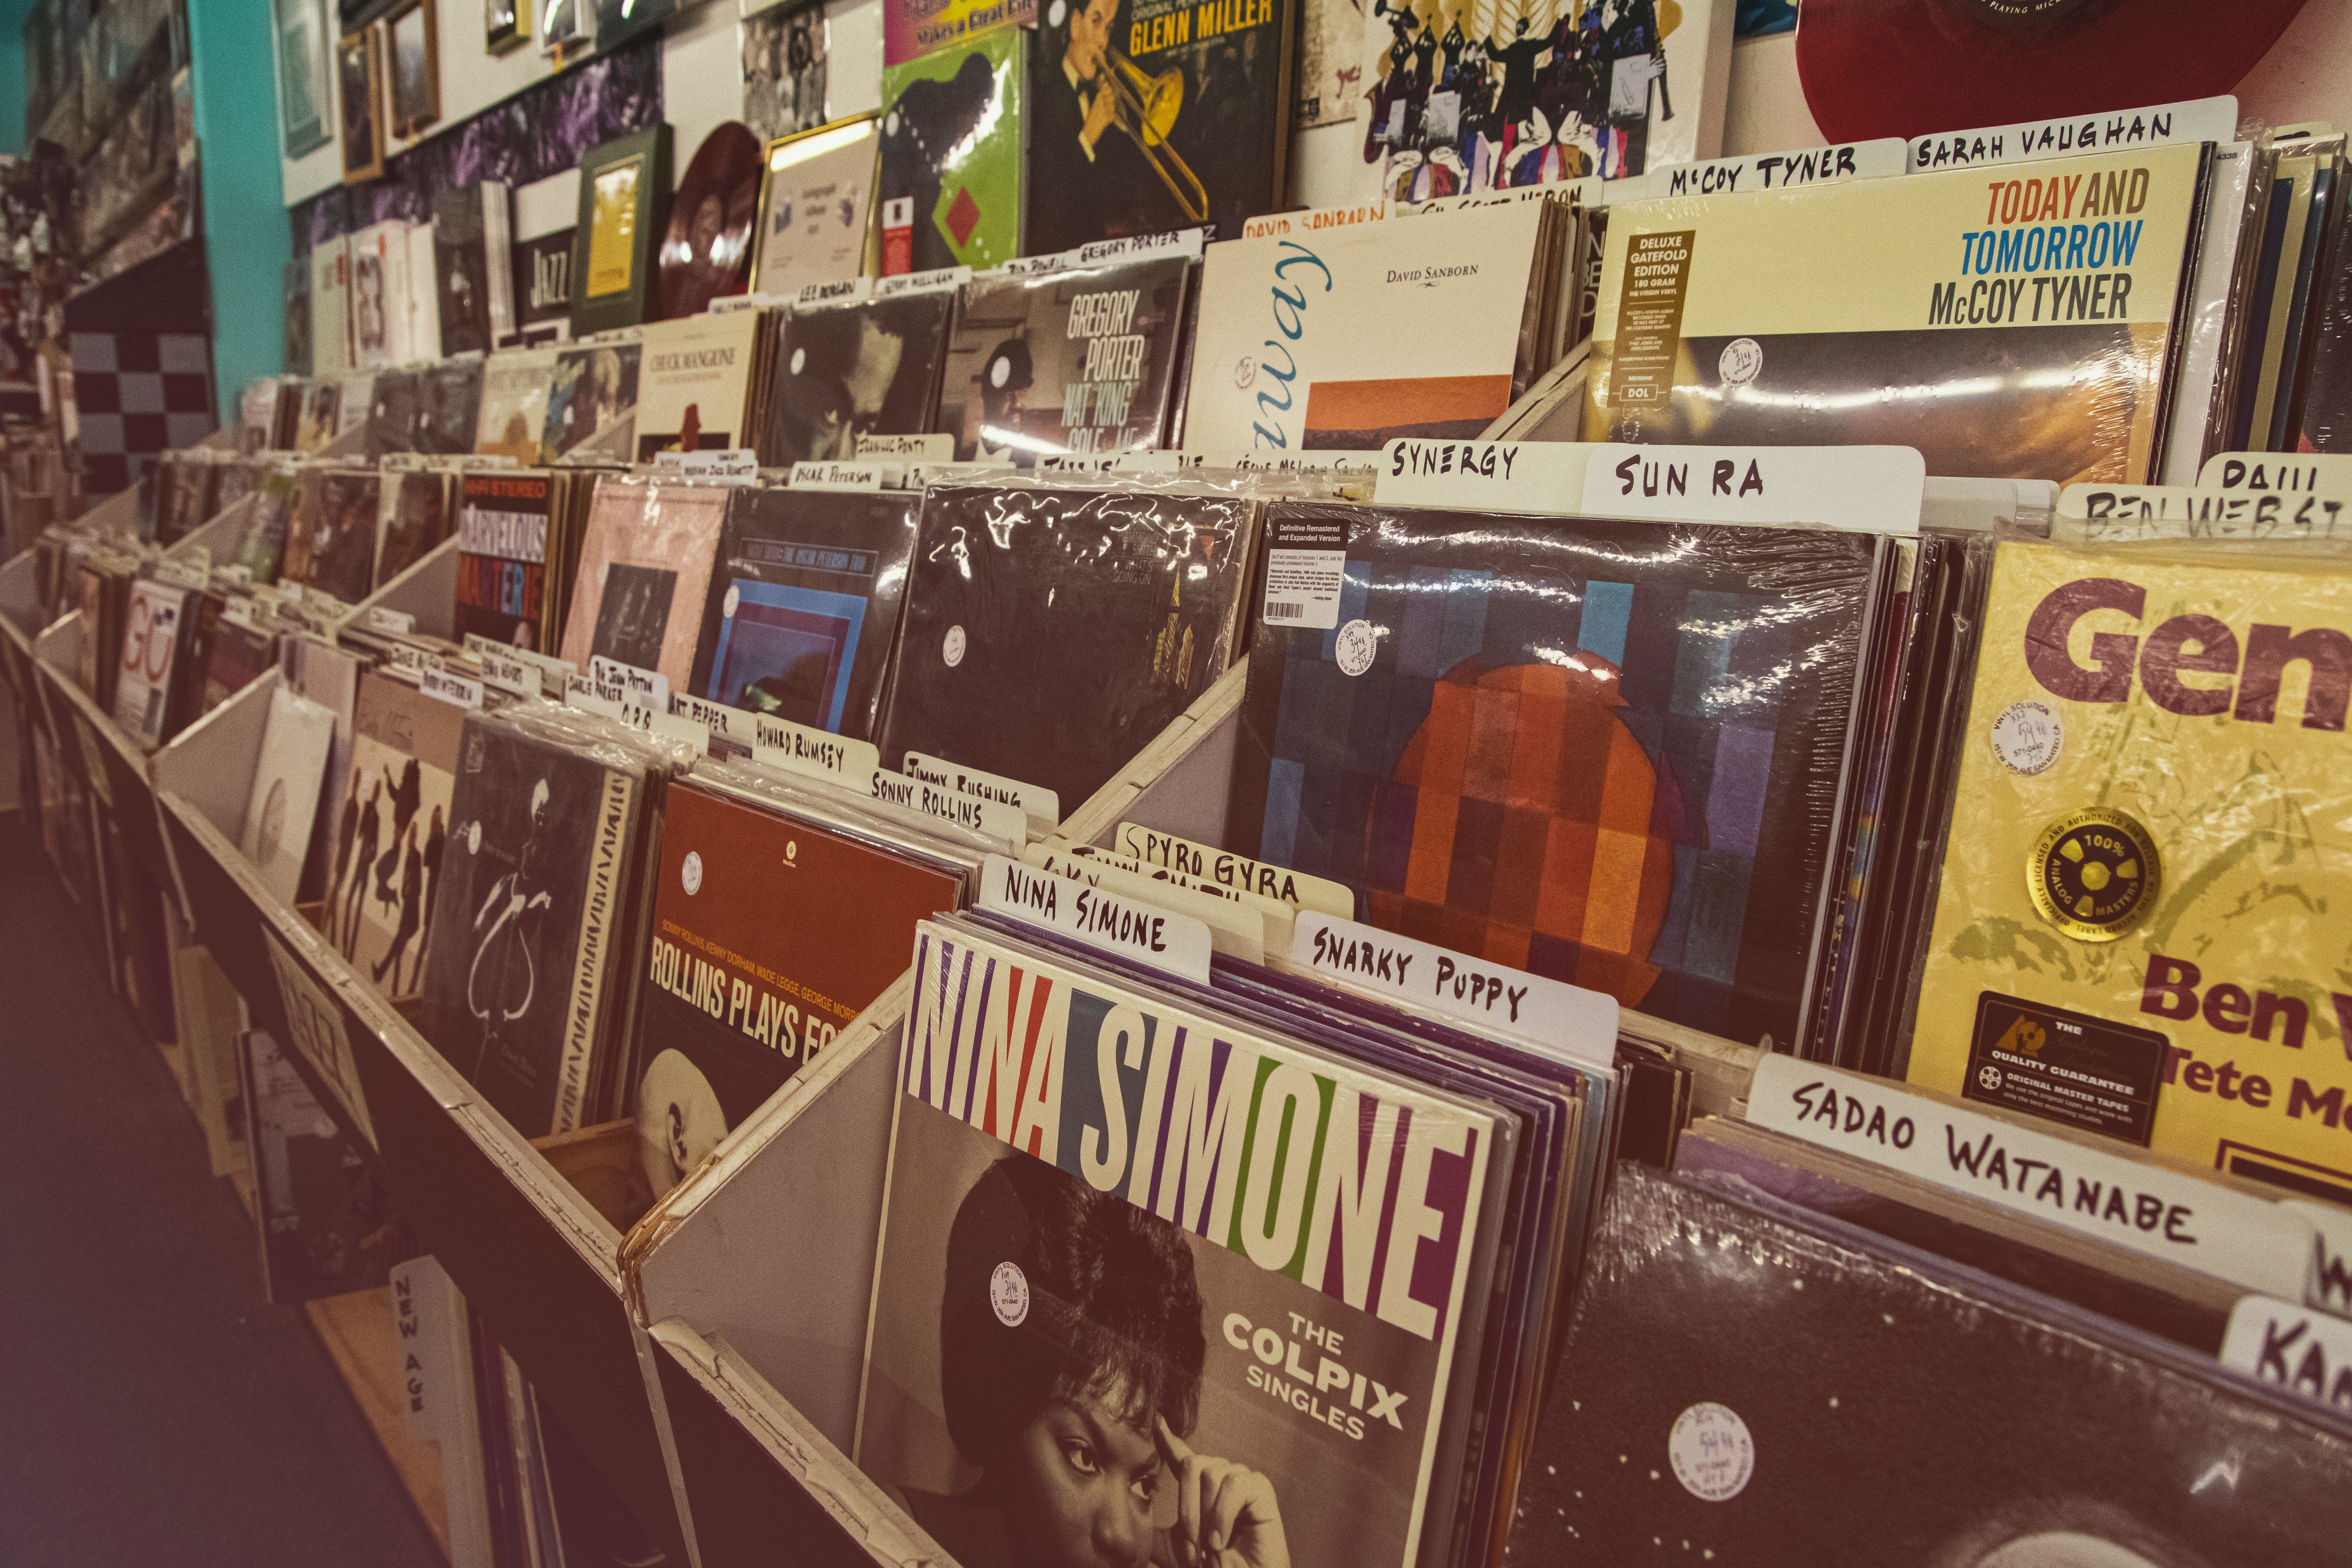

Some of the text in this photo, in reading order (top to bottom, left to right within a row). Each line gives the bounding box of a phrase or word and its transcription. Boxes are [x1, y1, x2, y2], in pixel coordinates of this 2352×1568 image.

[1130, 9, 1190, 57] GLENN
[1197, 0, 1272, 39] MILLER
[1990, 0, 2061, 13] PLAYING MIC
[1917, 113, 2172, 168] SARAH VAUGHAN
[1756, 147, 1856, 189] TYNER
[1987, 168, 2150, 225] TODAY AND
[1630, 249, 1687, 263] GATEFOLD
[1640, 236, 1683, 250] DELUXE
[1960, 220, 2144, 276] TOMORROW
[1634, 263, 1680, 277] EDITION
[1635, 278, 1675, 288] 180 GRAM
[1067, 289, 1141, 339] GREGORY
[1928, 273, 2132, 325] McCOY TYNER
[1083, 334, 1145, 382] PORTER
[1628, 389, 1649, 398] DOL
[1392, 441, 1519, 480] SYNERGY
[1615, 454, 1763, 498] SUN RA
[2086, 492, 2167, 539] BEN
[1344, 623, 1365, 634] SOLUTION
[667, 692, 687, 719] ART
[692, 702, 728, 733] PEPPER
[756, 718, 844, 772] HOWARD RUMSEY
[871, 771, 982, 829] SONNY ROLLINS
[906, 758, 1021, 809] JIMMY RUSHING
[1125, 825, 1203, 877] SPYRO
[1214, 854, 1300, 903] GYRA
[2084, 834, 2125, 858] 100%
[1005, 864, 1057, 921] NINA
[1076, 889, 1167, 953] SIMONE
[2051, 859, 2139, 916] ANALOG MASTERS
[1313, 926, 1413, 987] SNARKY
[649, 935, 843, 1066] ROLLINS PLAYS FO
[756, 965, 776, 984] WADE
[801, 986, 833, 1011] GEORGE
[2140, 953, 2309, 1049] Ben
[2055, 1021, 2083, 1035] THE
[1991, 1050, 2047, 1071] QUALITY
[2049, 1066, 2135, 1096] GUARANTEE
[2006, 1072, 2130, 1113] ORIGINAL MASTER TAPES
[2162, 1045, 2272, 1109] Tete
[907, 931, 1072, 1167] NINA
[1079, 1004, 1469, 1342] SIMONE
[1792, 1081, 2198, 1246] SADAO WATANABE
[993, 1265, 1002, 1279] VINYL
[1003, 1263, 1023, 1279] SOLUTION
[395, 1276, 423, 1413] NEW AGE
[1288, 1311, 1345, 1356] THE
[1222, 1312, 1409, 1430] COLPIX
[1246, 1364, 1366, 1441] SINGLES
